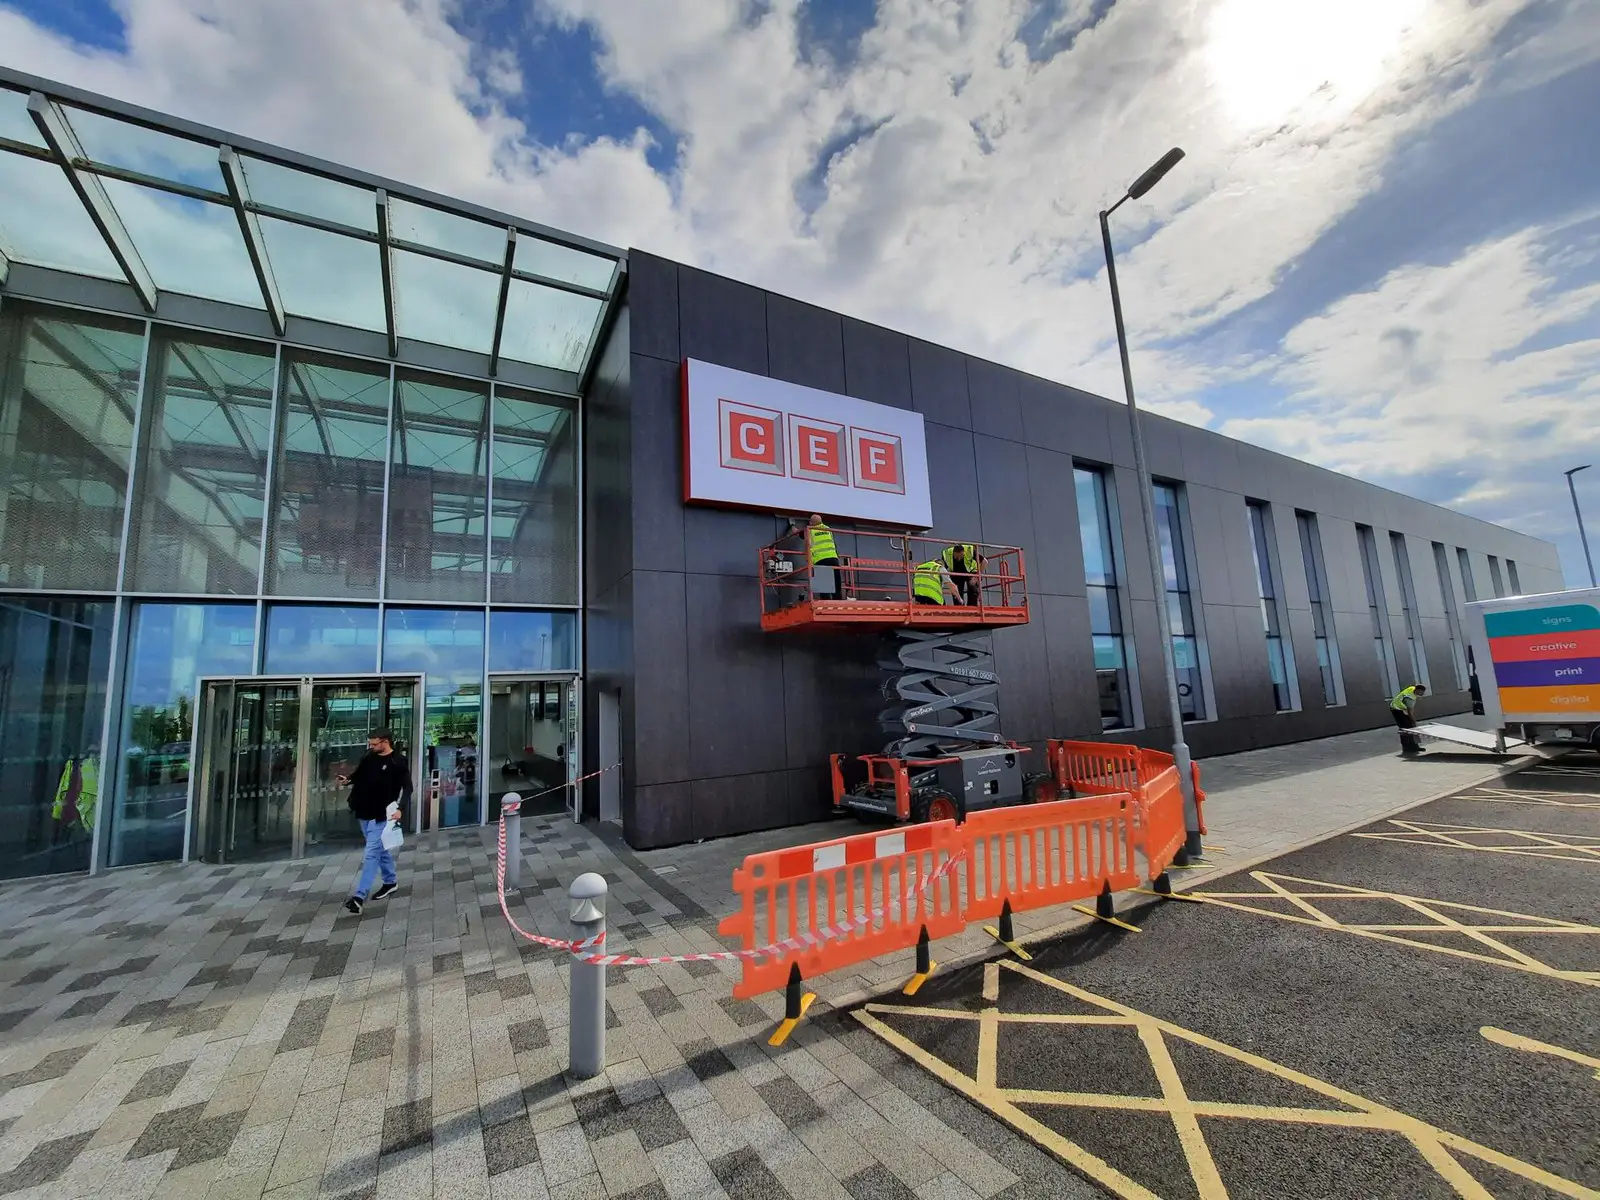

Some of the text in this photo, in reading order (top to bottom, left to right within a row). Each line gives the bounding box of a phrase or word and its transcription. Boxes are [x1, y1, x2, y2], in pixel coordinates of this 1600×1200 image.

[739, 422, 887, 475] CEF
[1542, 616, 1572, 626] signs
[1529, 642, 1577, 652] creative
[1555, 667, 1584, 677] print
[1550, 695, 1589, 705] digital
